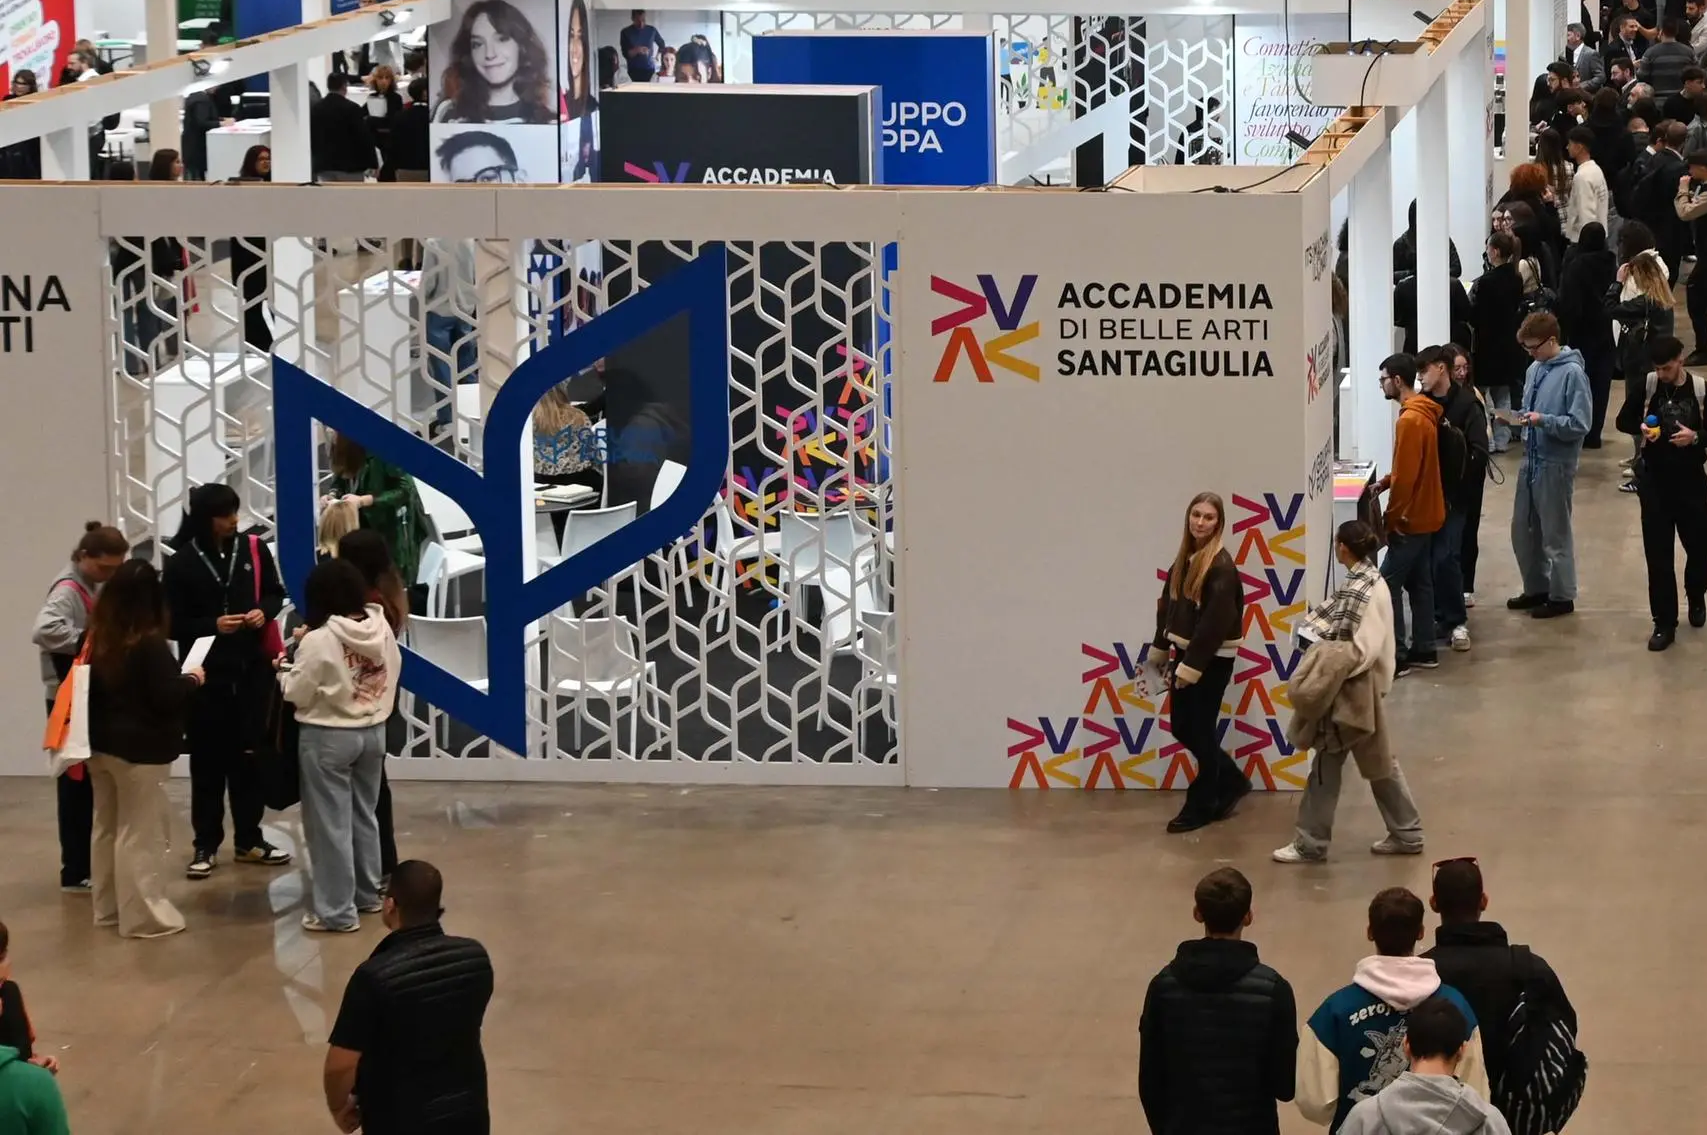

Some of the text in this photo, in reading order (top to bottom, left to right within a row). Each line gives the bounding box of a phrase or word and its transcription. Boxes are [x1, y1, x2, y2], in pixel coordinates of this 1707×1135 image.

[1, 275, 71, 311] NA
[1057, 282, 1273, 310] ACCADEMIA
[0, 316, 33, 352] TI
[1060, 318, 1268, 341] DI BELLE ARTI
[1057, 349, 1274, 377] SANTAGIULIA
[1349, 1003, 1390, 1026] zero
